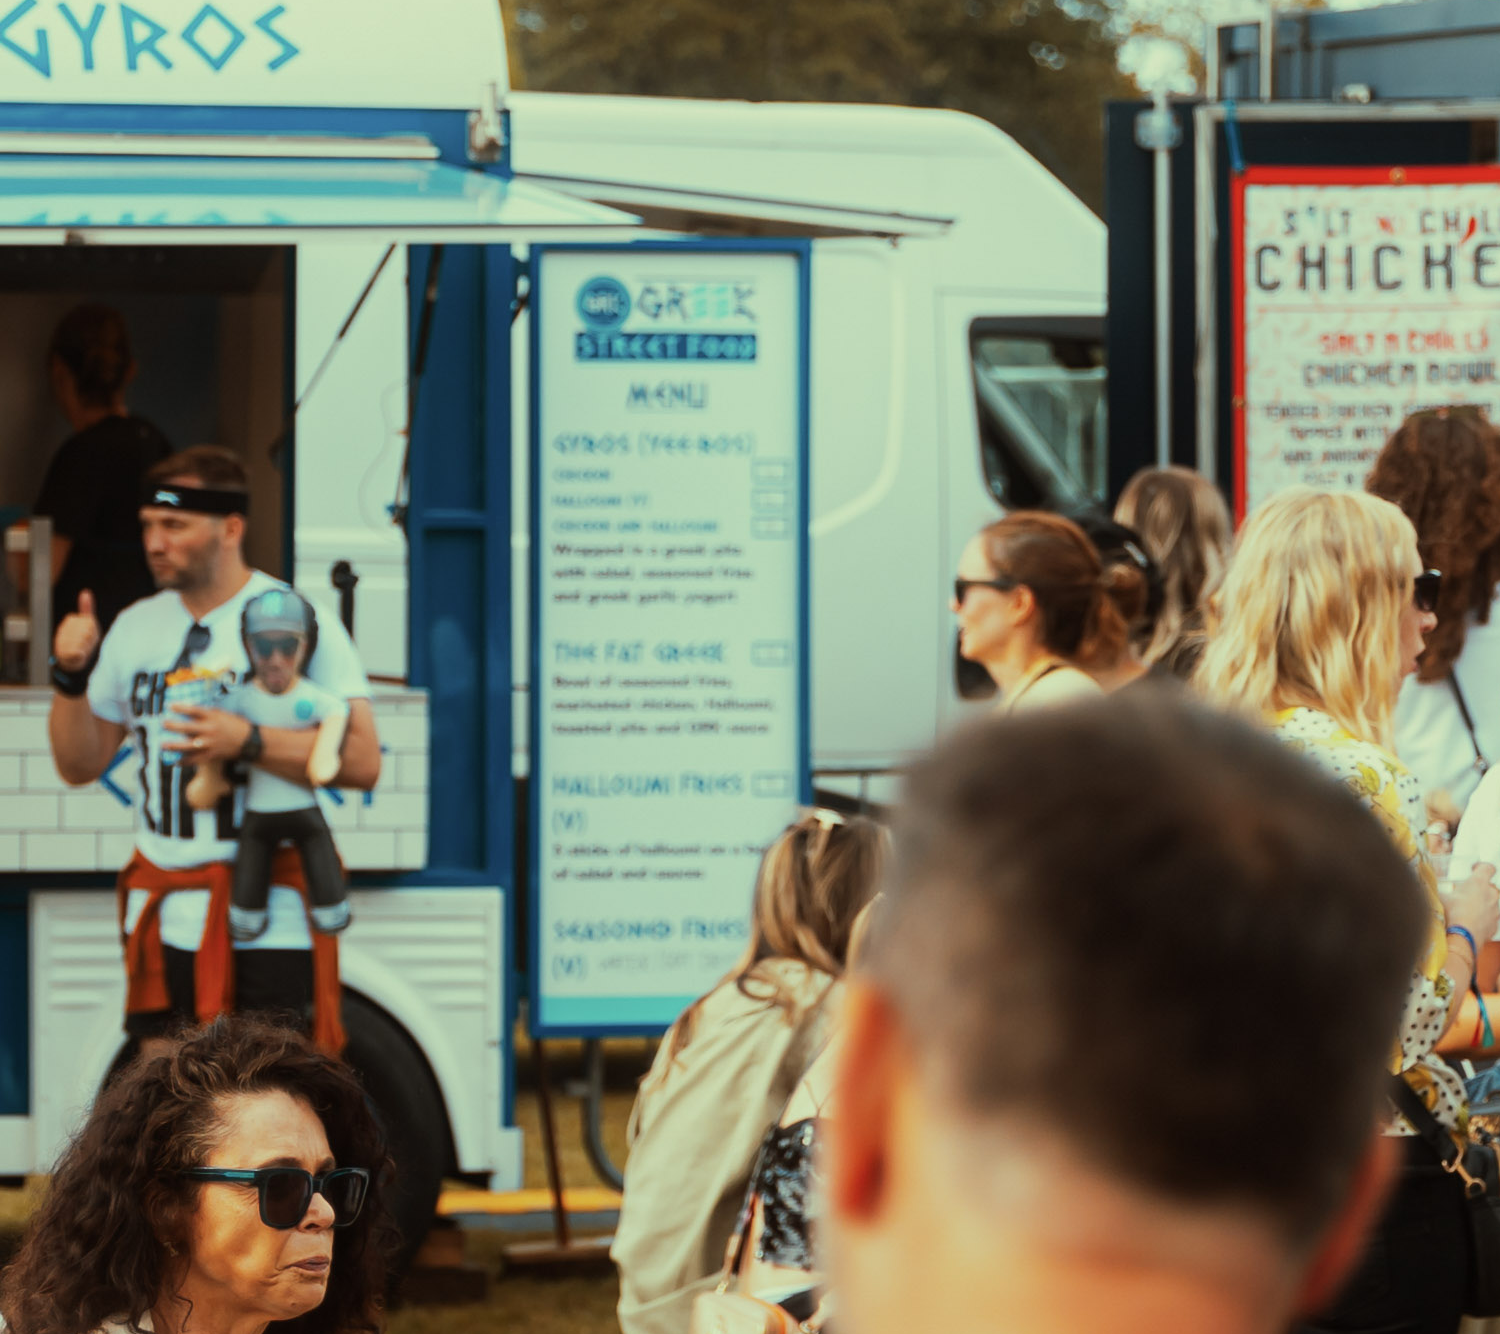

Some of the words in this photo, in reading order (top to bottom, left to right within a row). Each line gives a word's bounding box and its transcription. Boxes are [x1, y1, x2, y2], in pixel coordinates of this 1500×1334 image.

[686, 334, 756, 359] FOOD
[627, 382, 707, 410] MENU
[553, 431, 631, 457] GYROS
[553, 640, 598, 664] THE
[604, 640, 644, 664] FAT
[551, 774, 671, 798] HALLOUMI
[678, 774, 743, 797] FRIES
[554, 918, 673, 943] SEASONED
